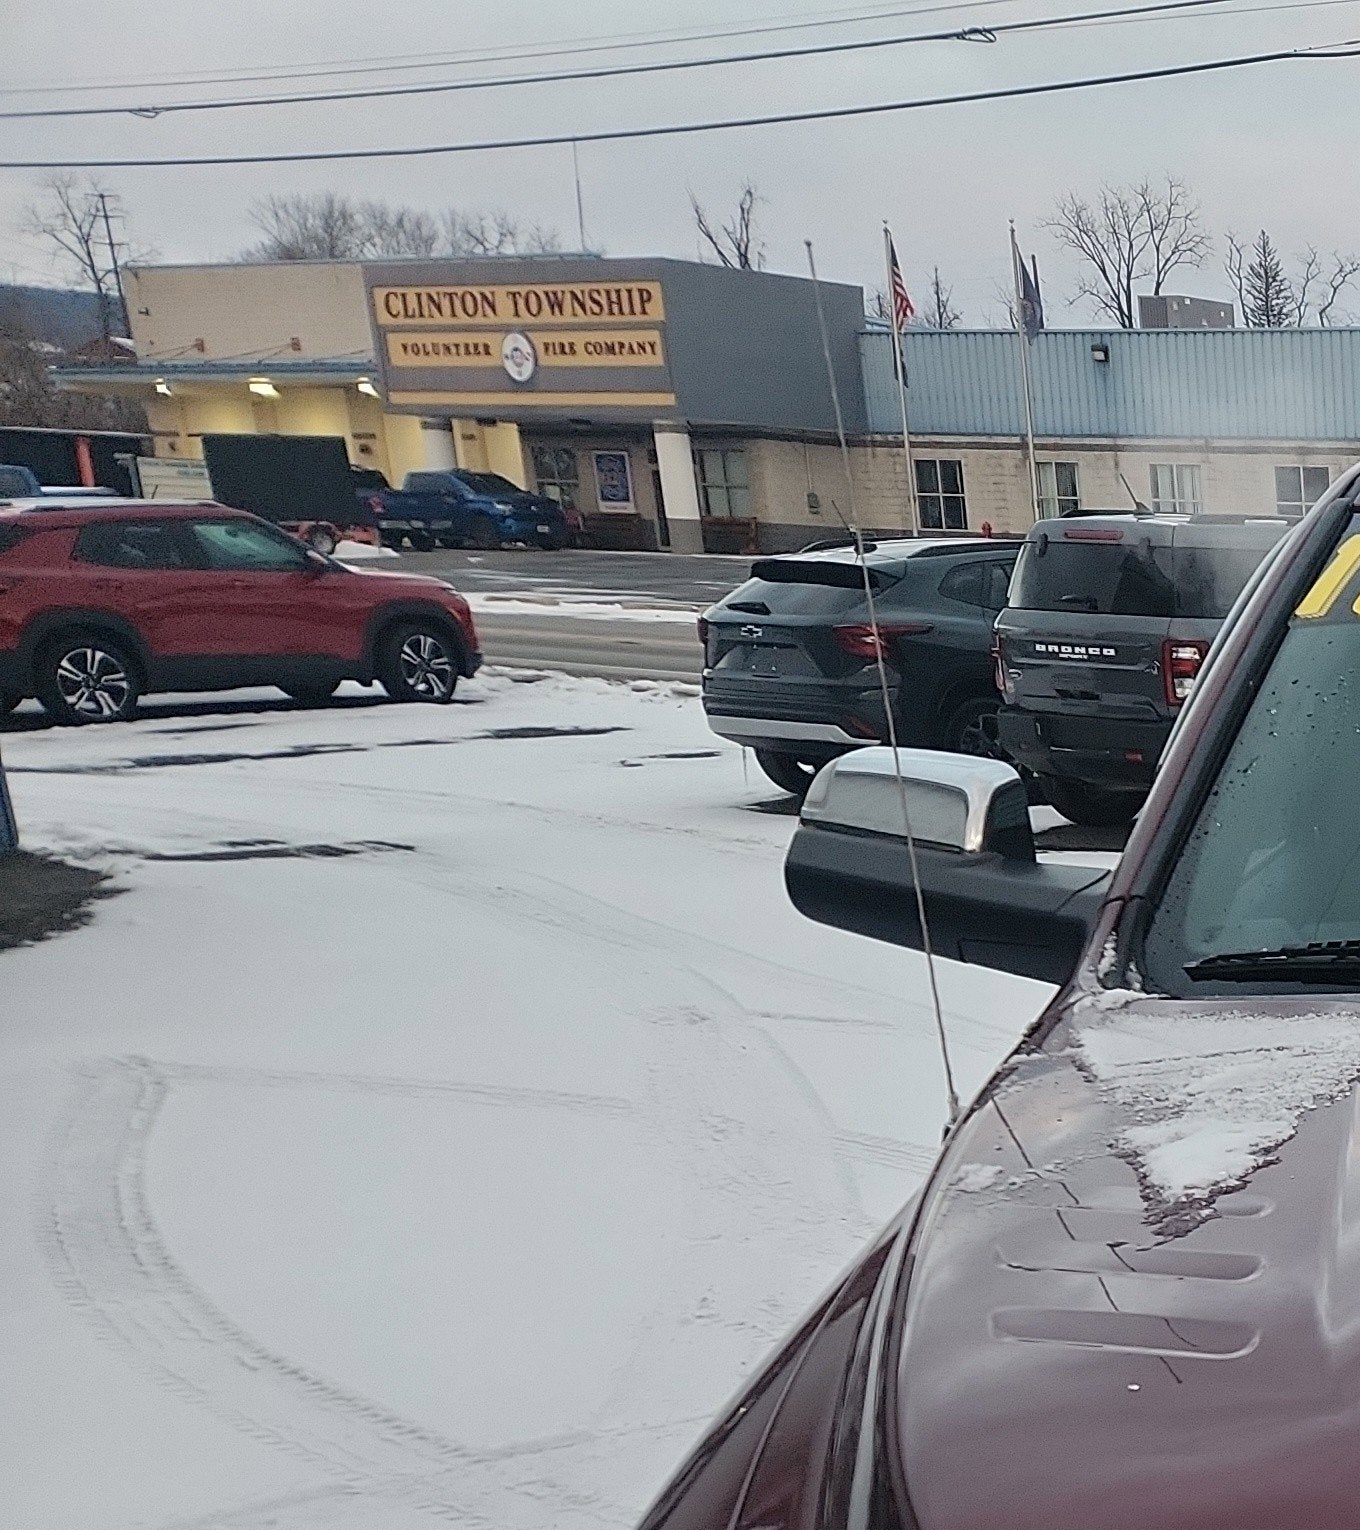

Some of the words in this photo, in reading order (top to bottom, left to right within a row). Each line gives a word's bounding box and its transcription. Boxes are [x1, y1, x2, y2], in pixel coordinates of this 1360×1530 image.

[384, 290, 497, 318] CLINTON
[506, 288, 652, 318] TOWNSHIP
[401, 342, 493, 357] VOLUNTEER
[543, 341, 577, 356] FIRE
[584, 340, 657, 356] COMPANY
[1035, 643, 1116, 656] BRONCO
